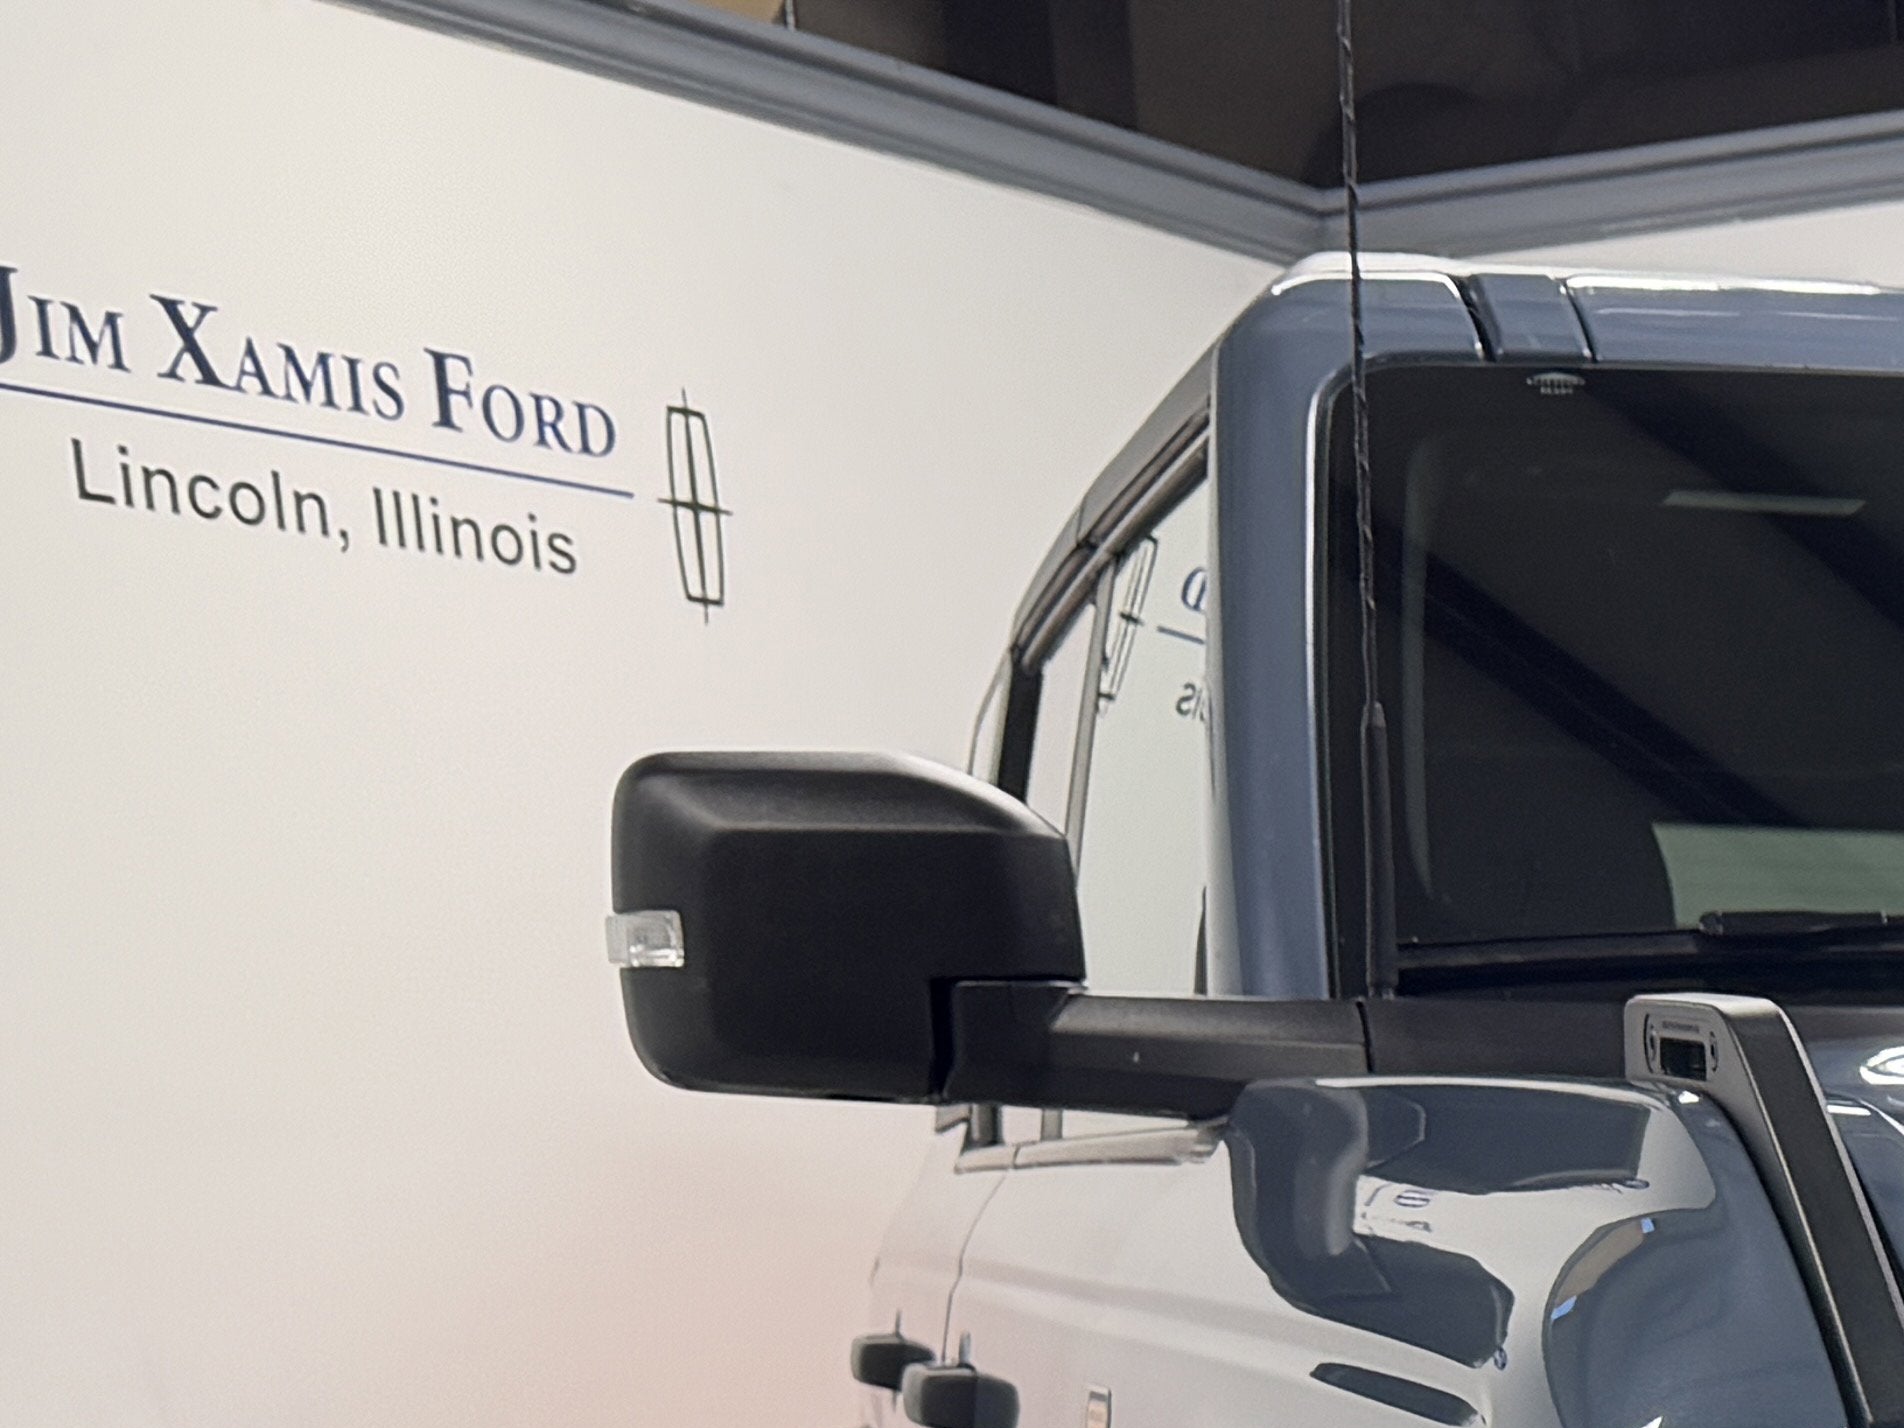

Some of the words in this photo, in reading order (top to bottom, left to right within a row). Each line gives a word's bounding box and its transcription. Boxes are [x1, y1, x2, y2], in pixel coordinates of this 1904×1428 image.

[149, 293, 405, 421] XAMIS
[423, 347, 617, 457] FORD
[71, 437, 349, 553] Lincoln,
[372, 487, 577, 575] Illinois
